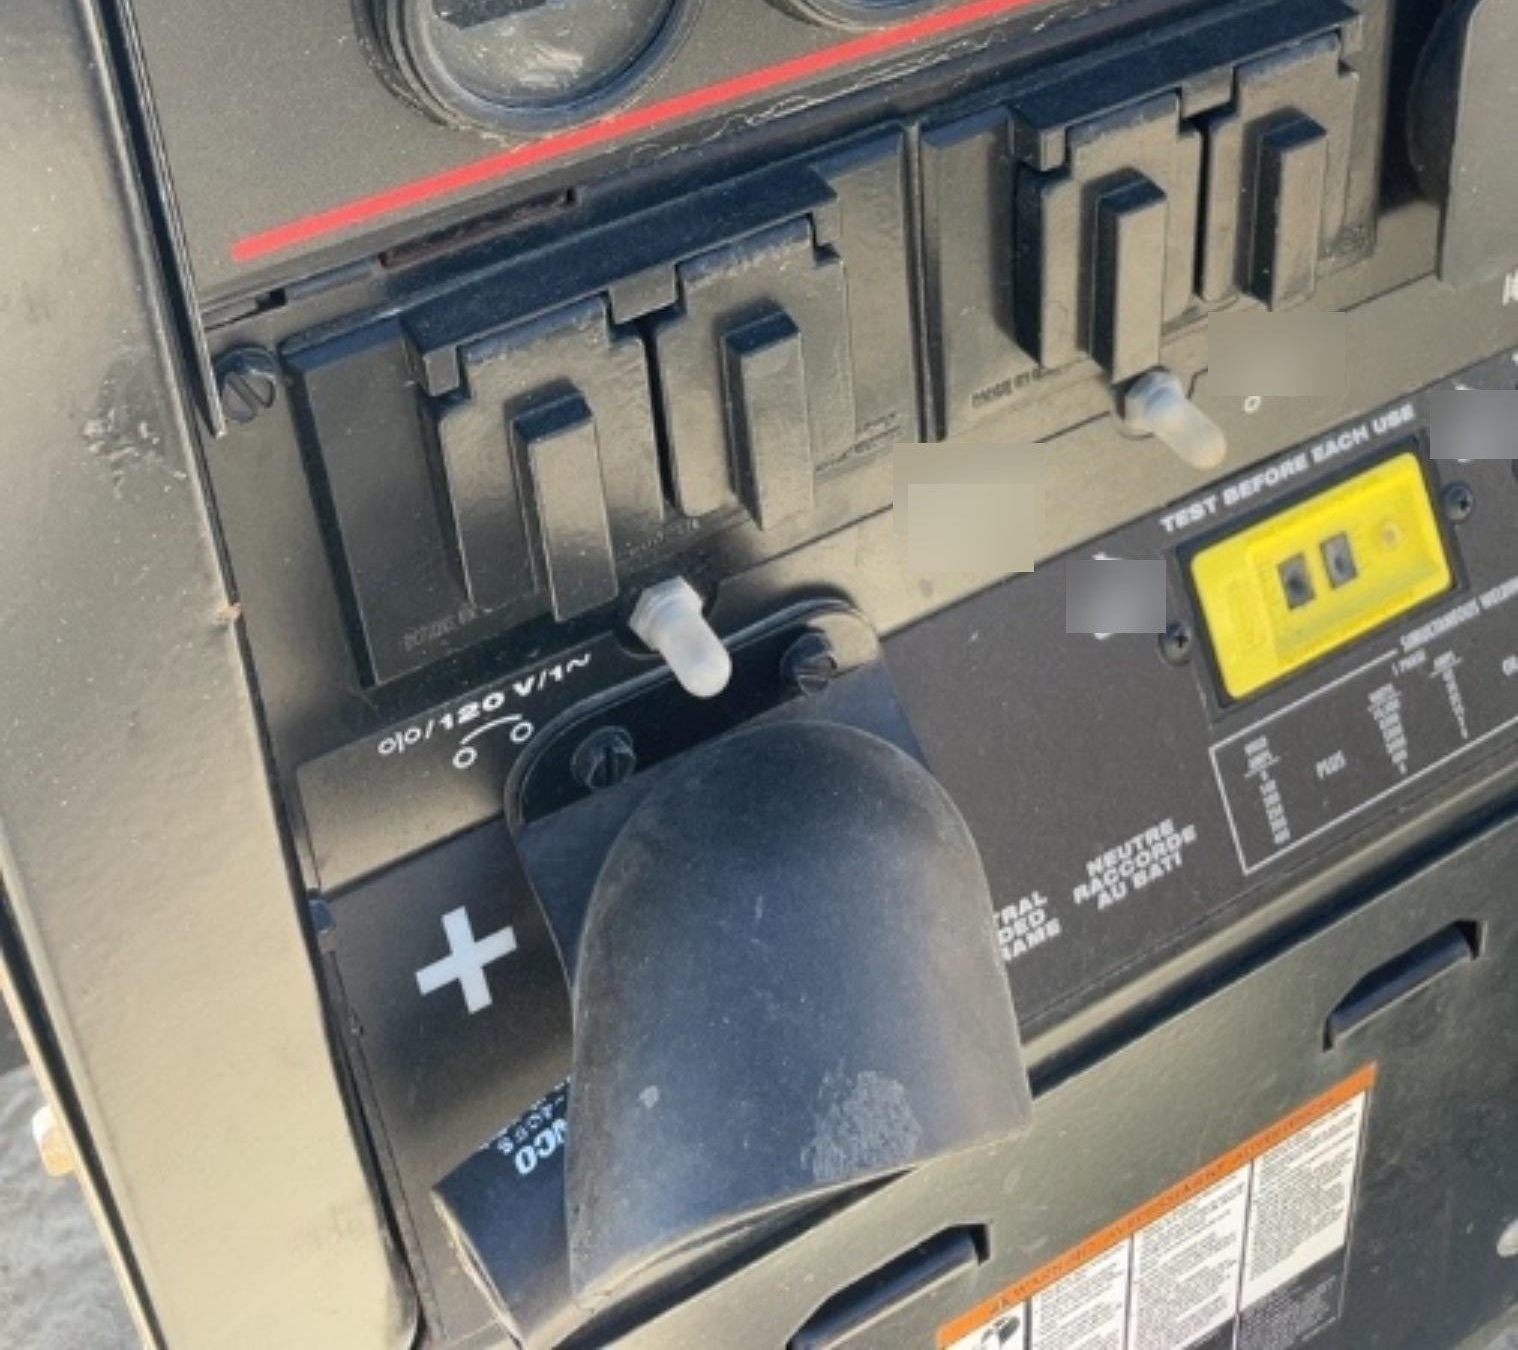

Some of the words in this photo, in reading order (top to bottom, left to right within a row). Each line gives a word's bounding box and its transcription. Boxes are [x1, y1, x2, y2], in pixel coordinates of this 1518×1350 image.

[1159, 497, 1217, 532] TEST
[1222, 453, 1308, 506] BEFORE
[1311, 424, 1369, 465] EACH
[1373, 403, 1415, 435] USE
[1097, 881, 1127, 910] AU
